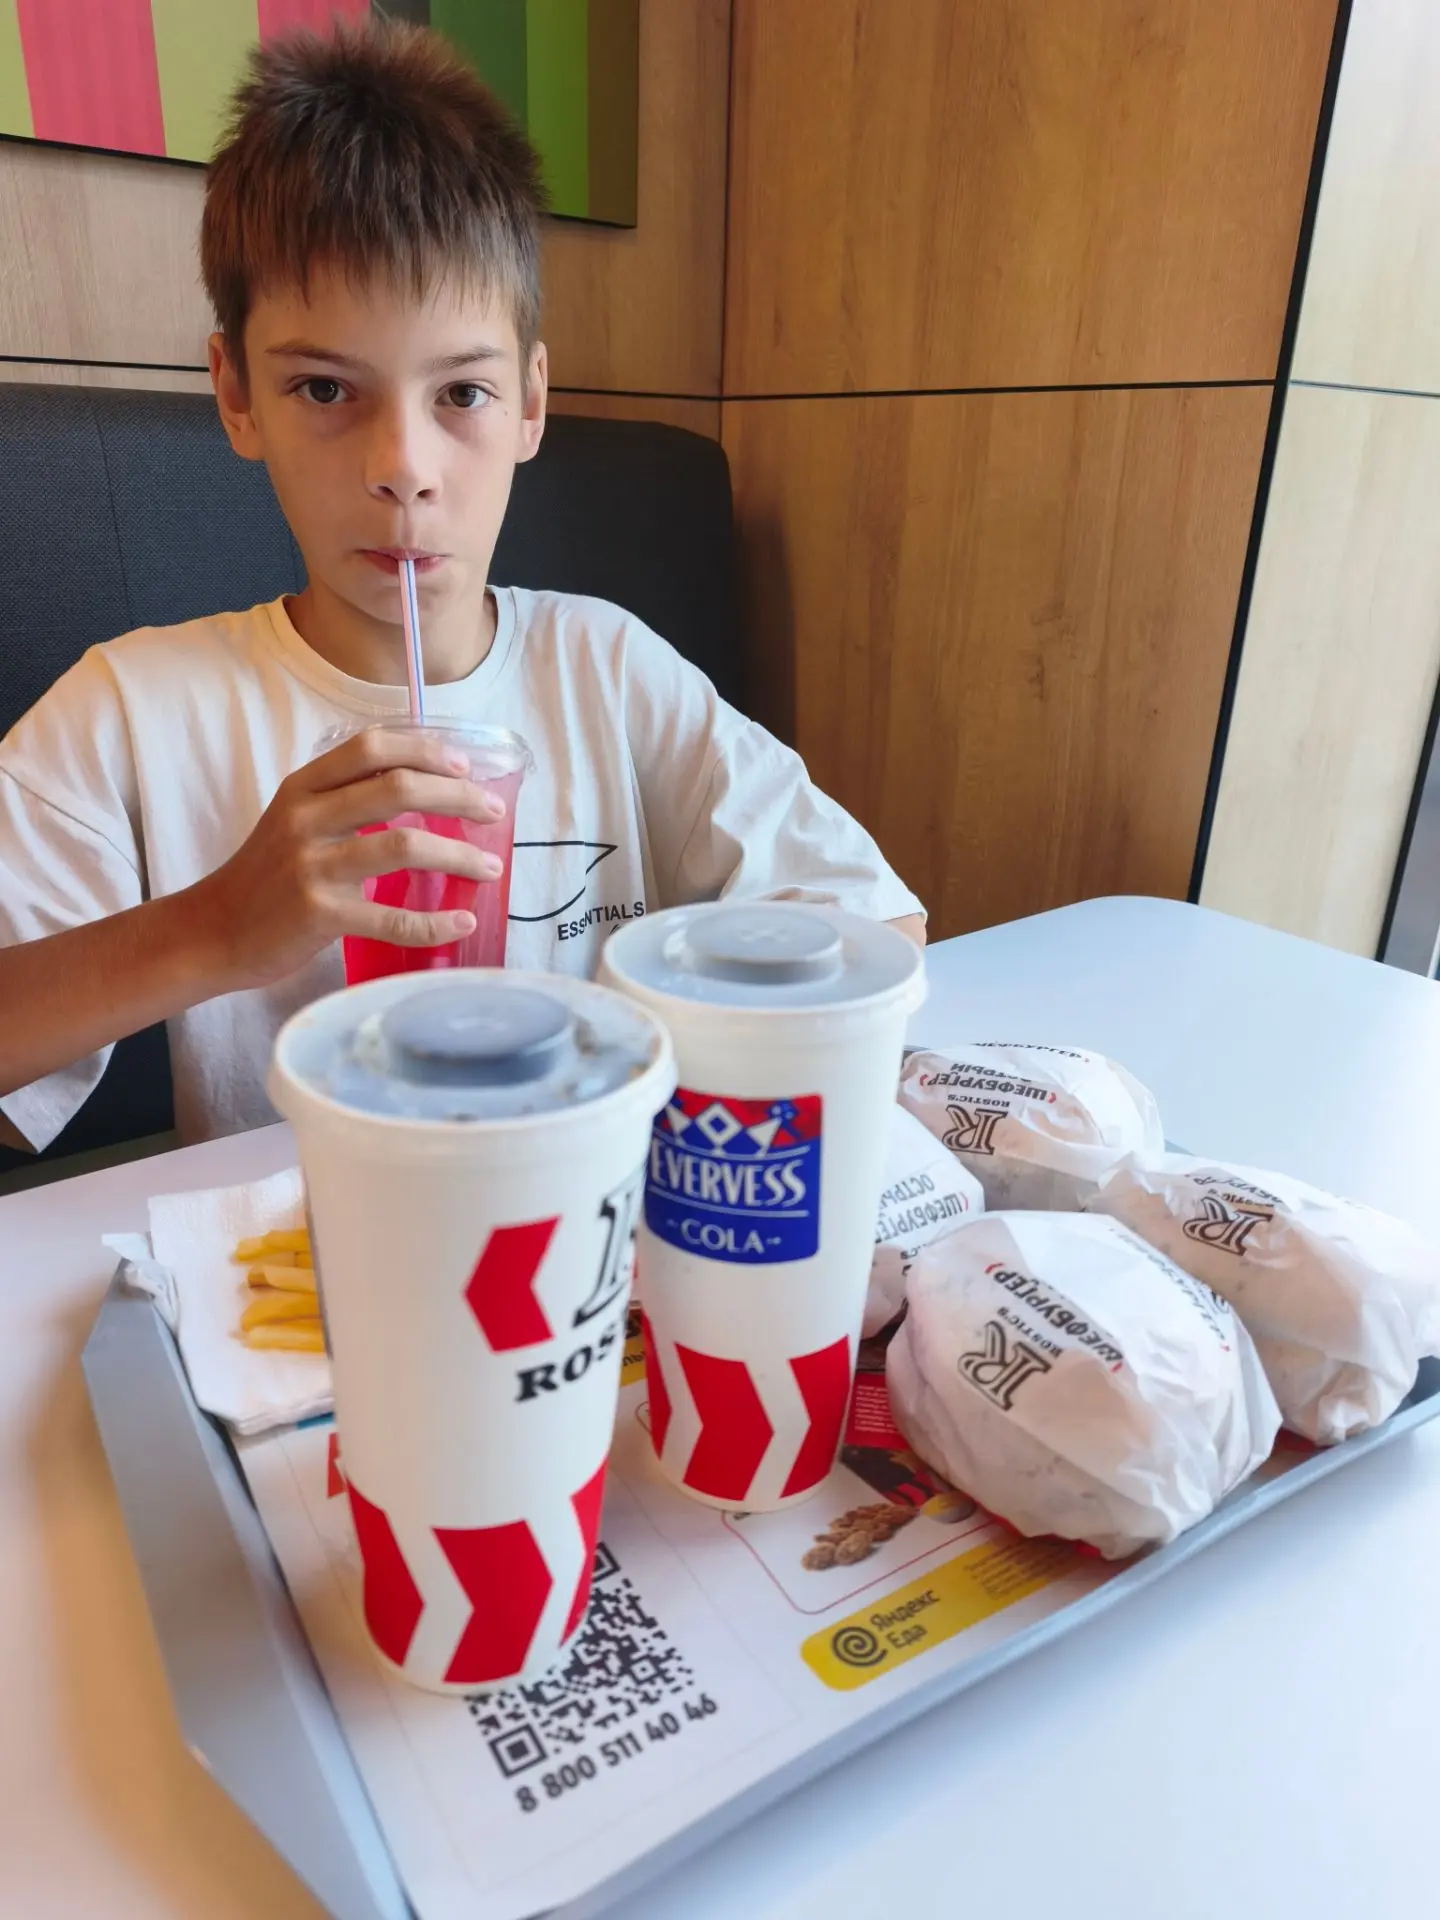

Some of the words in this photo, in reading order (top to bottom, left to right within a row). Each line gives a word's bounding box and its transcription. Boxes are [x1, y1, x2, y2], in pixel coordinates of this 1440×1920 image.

[557, 901, 645, 941] ESSNTIALS
[947, 1093, 1011, 1108] ROSTIC'S
[650, 1138, 807, 1208] EVERVESS
[681, 1218, 766, 1255] COLA
[996, 1306, 1064, 1360] ROSTIC'S
[870, 1589, 941, 1631] Яндекс
[886, 1624, 928, 1649] Еда
[515, 1785, 539, 1813] 8
[541, 1755, 597, 1799] 800
[599, 1732, 643, 1767] 511
[645, 1711, 681, 1743] 40
[683, 1692, 718, 1721] 46
